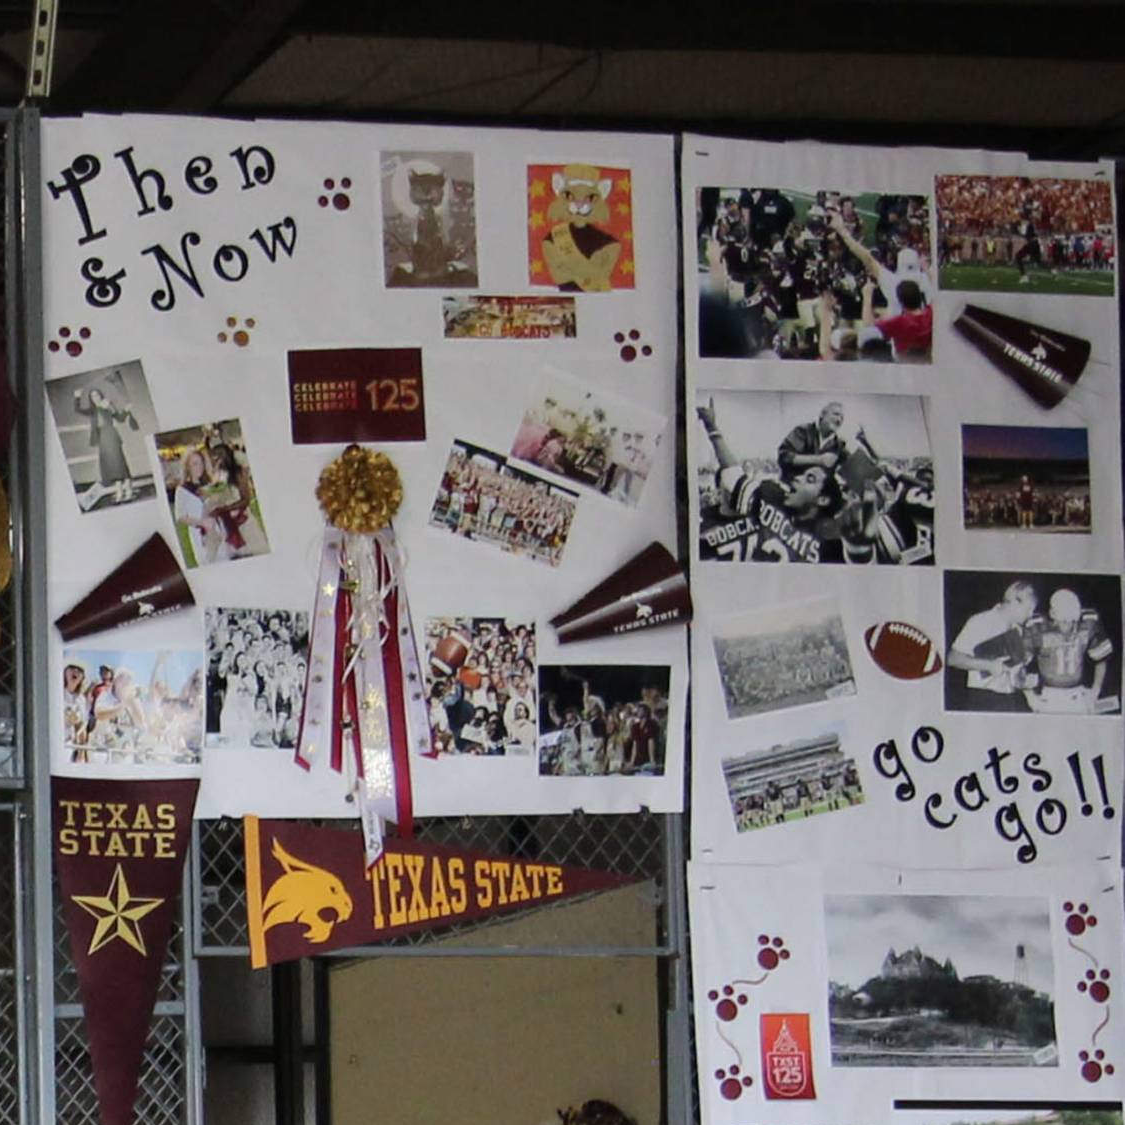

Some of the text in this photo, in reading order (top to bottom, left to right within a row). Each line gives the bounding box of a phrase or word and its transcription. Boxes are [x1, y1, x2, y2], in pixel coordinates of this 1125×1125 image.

[47, 144, 276, 246] Then
[81, 216, 297, 311] & Now
[365, 379, 420, 411] 125
[613, 608, 679, 633] TEXAS STATE
[874, 726, 945, 802] go
[924, 747, 1053, 829] cats
[58, 800, 176, 830] TEXAS
[59, 829, 176, 858] STATE
[365, 853, 563, 929] TEXAS STATE
[773, 1067, 802, 1084] 125
